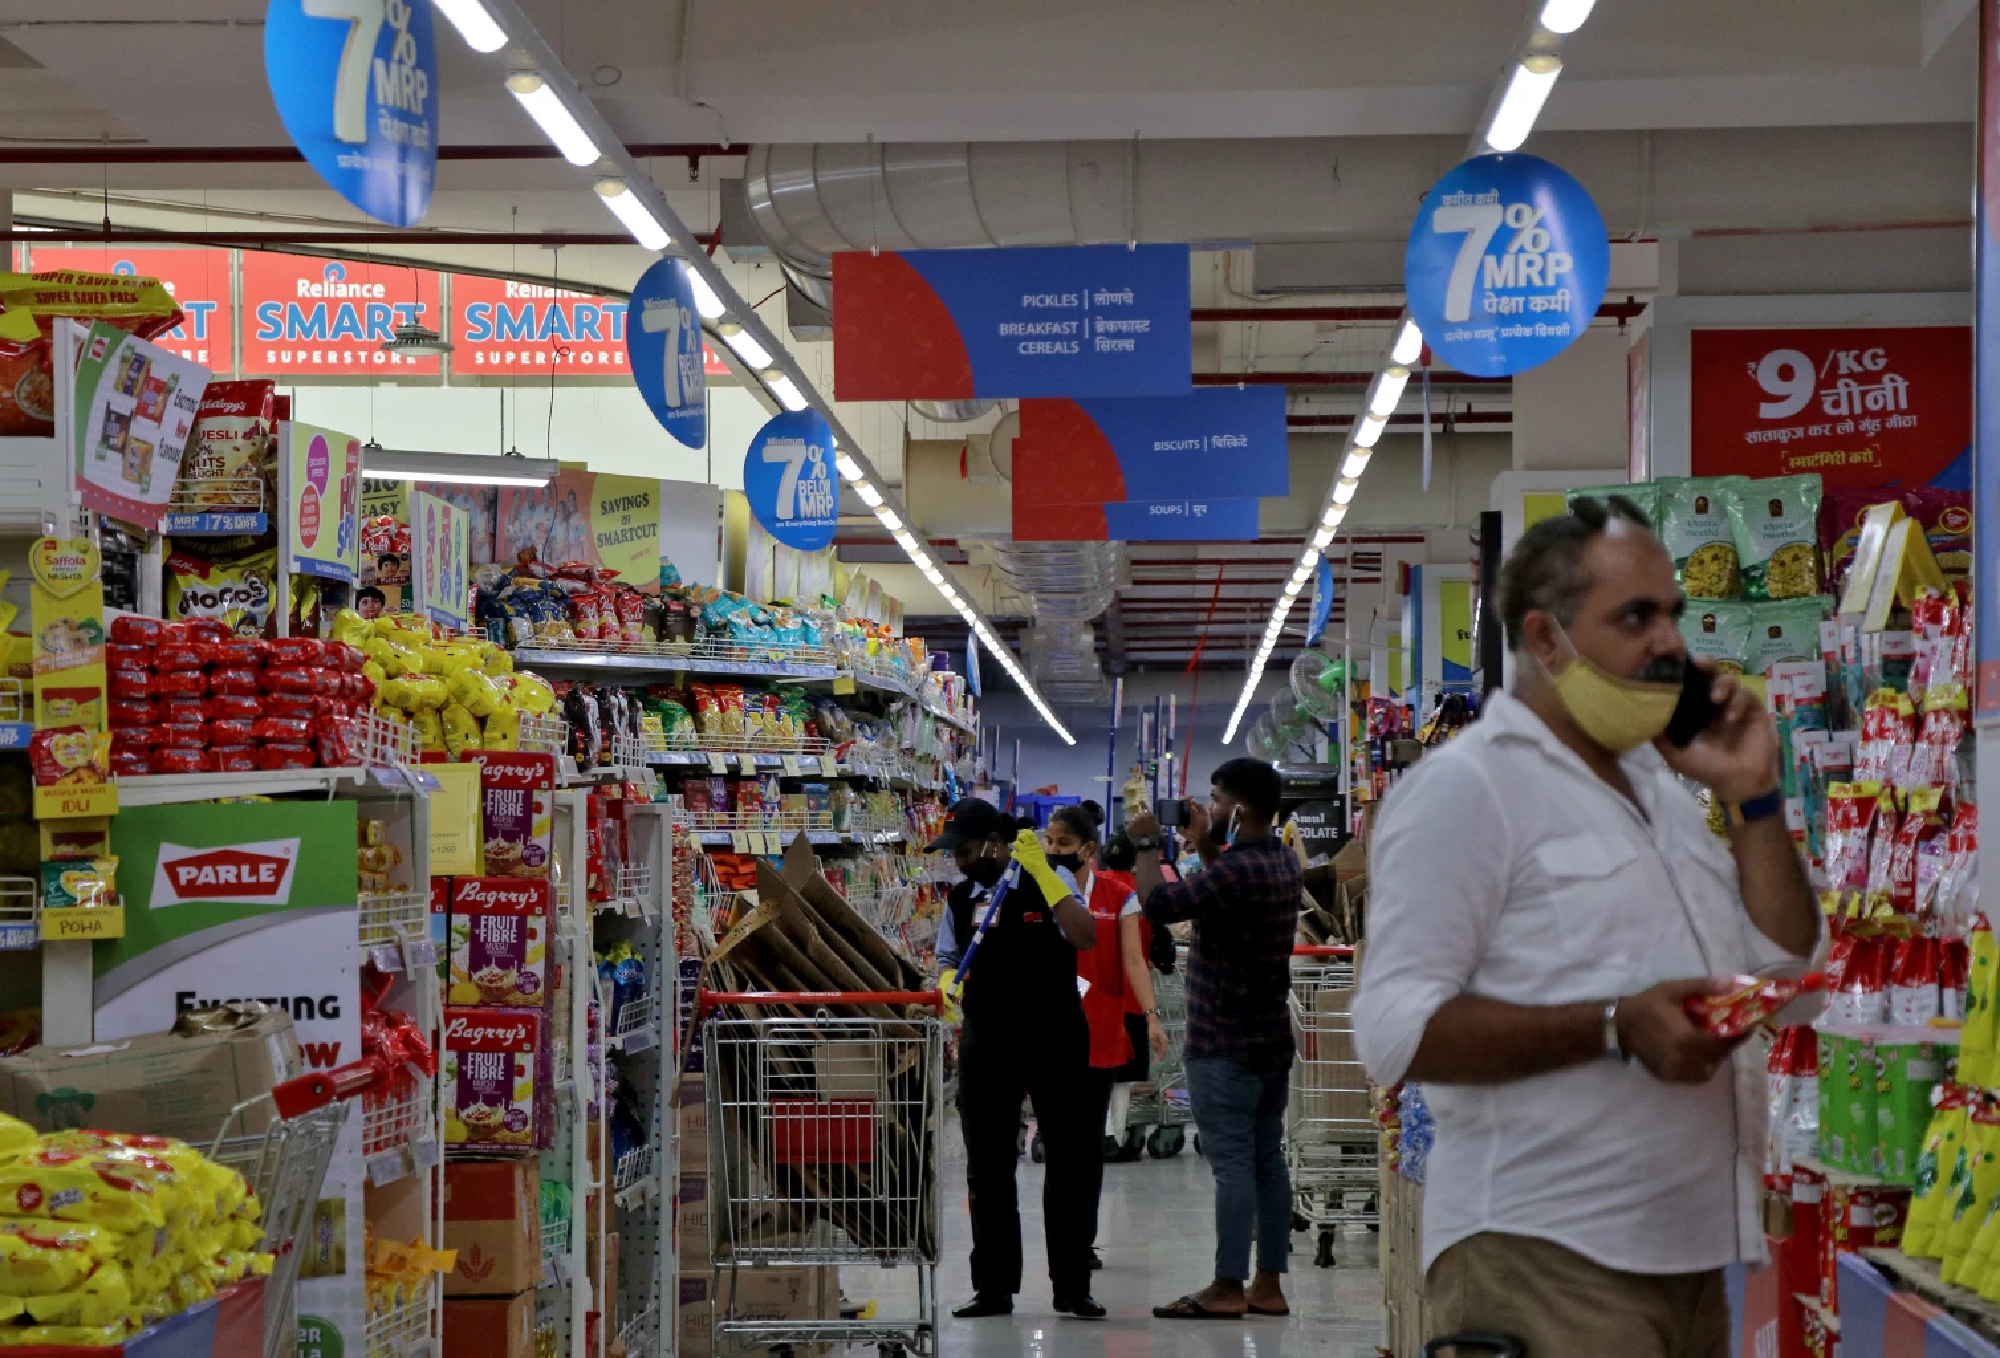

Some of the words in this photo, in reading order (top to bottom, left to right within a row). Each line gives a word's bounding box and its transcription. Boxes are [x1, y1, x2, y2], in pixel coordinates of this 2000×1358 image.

[374, 57, 428, 115] MRP
[1483, 252, 1573, 289] MRP
[297, 275, 386, 298] Reliance
[1023, 293, 1078, 308] PICKLES
[1483, 291, 1525, 315] पेक्षा
[1528, 288, 1571, 313] कमी
[256, 301, 427, 341] SMART
[465, 302, 628, 342] SMART
[1000, 321, 1078, 335] BREAKFAST
[1019, 341, 1080, 354] CEREALS
[475, 351, 623, 364] SUPERSTORE
[1820, 373, 1910, 416] चीनी
[1808, 423, 1832, 436] कर
[1836, 418, 1854, 435] लो
[767, 436, 805, 447] Minimum
[1154, 439, 1200, 451] BISCUITS
[601, 493, 650, 515] SAVINGS
[800, 495, 834, 518] MRP
[1150, 504, 1183, 515] SOUPS
[174, 516, 200, 525] MRP
[597, 523, 658, 548] SMARTCUT
[44, 556, 86, 566] Saffola
[487, 788, 525, 803] FRUIT
[61, 800, 90, 813] IDLI
[487, 802, 524, 817] FIBRE
[1289, 811, 1325, 823] Amul
[175, 862, 277, 886] PARLE
[60, 919, 103, 935] POHA
[481, 915, 519, 930] FRUIT
[480, 929, 517, 943] FIBRE
[467, 1052, 505, 1066] FRUIT
[466, 1066, 504, 1080] FIBRE
